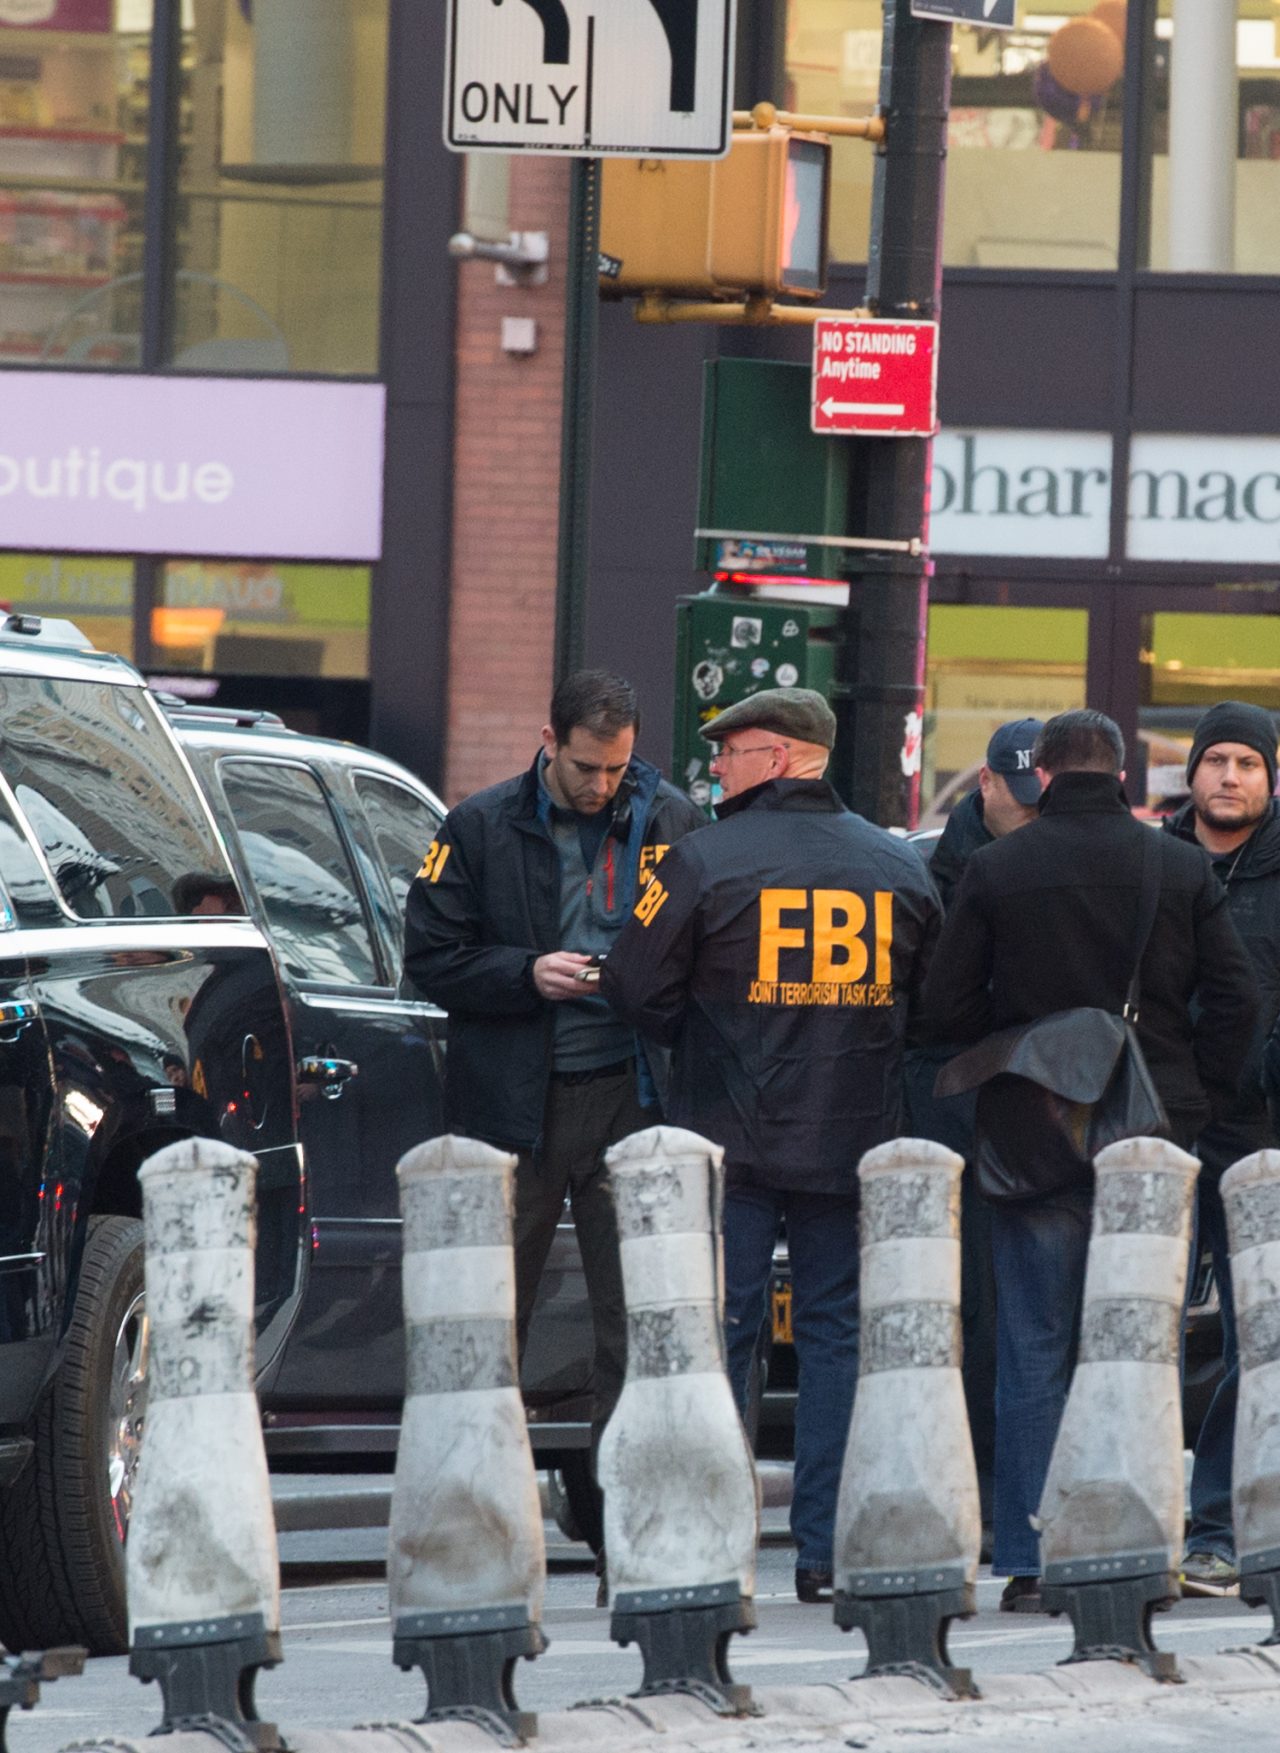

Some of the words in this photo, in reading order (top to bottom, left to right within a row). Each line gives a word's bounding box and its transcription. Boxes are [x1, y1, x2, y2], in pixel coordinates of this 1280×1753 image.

[461, 82, 579, 125] ONLY
[821, 331, 843, 352] NO
[845, 331, 916, 355] STANDING
[821, 356, 881, 383] Anytime
[416, 840, 451, 883] BI
[633, 875, 670, 928] BI
[758, 888, 894, 985] FBI
[748, 980, 779, 1003] JOINT
[780, 982, 840, 1006] TERRORISM
[841, 983, 867, 1005] TASK
